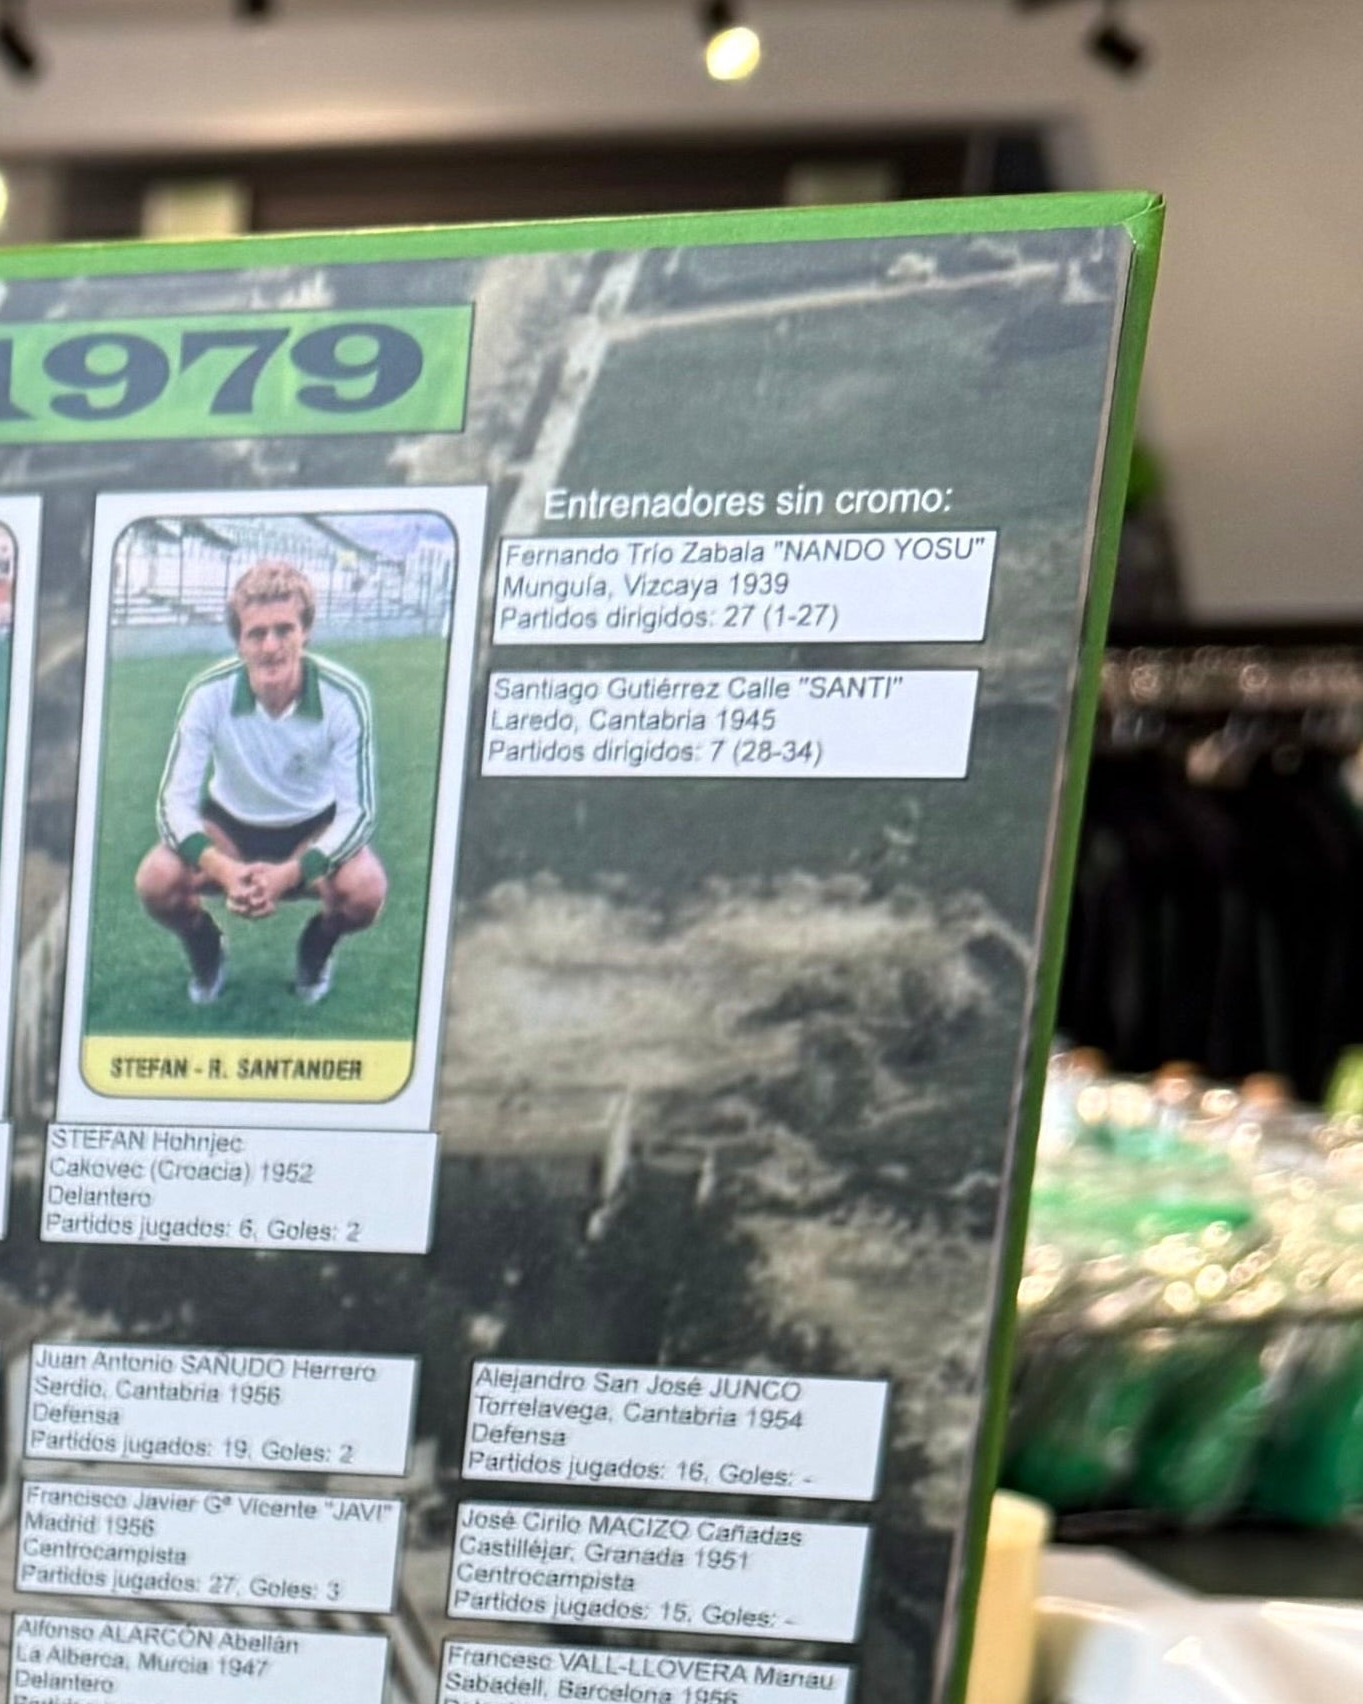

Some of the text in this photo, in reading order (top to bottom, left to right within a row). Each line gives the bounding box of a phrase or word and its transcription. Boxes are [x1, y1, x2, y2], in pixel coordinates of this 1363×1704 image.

[545, 487, 953, 520] Entrenadores sin cromo:
[505, 536, 985, 567] Fernando Trío Zabala "NANDO YOSU"
[502, 573, 788, 601] Munguía, Vizcaya 1939
[501, 603, 839, 634] Partidos dirigidos: 27 (1-27)
[495, 676, 903, 705] Santiago Gutiérrez Calle "SANTI"
[490, 708, 776, 734] Laredo, Cantabria 1945
[488, 738, 823, 766] Partidos dirigidos: 7 (28-34)
[110, 1057, 362, 1080] STEFAN R. SANTANDER
[51, 1129, 145, 1150] STEFAN
[150, 1159, 250, 1185] (Croacia)
[262, 1162, 314, 1183] 1952
[48, 1186, 151, 1207] Delantero
[46, 1213, 360, 1241] Partidos jugados: 6, Goles: 2
